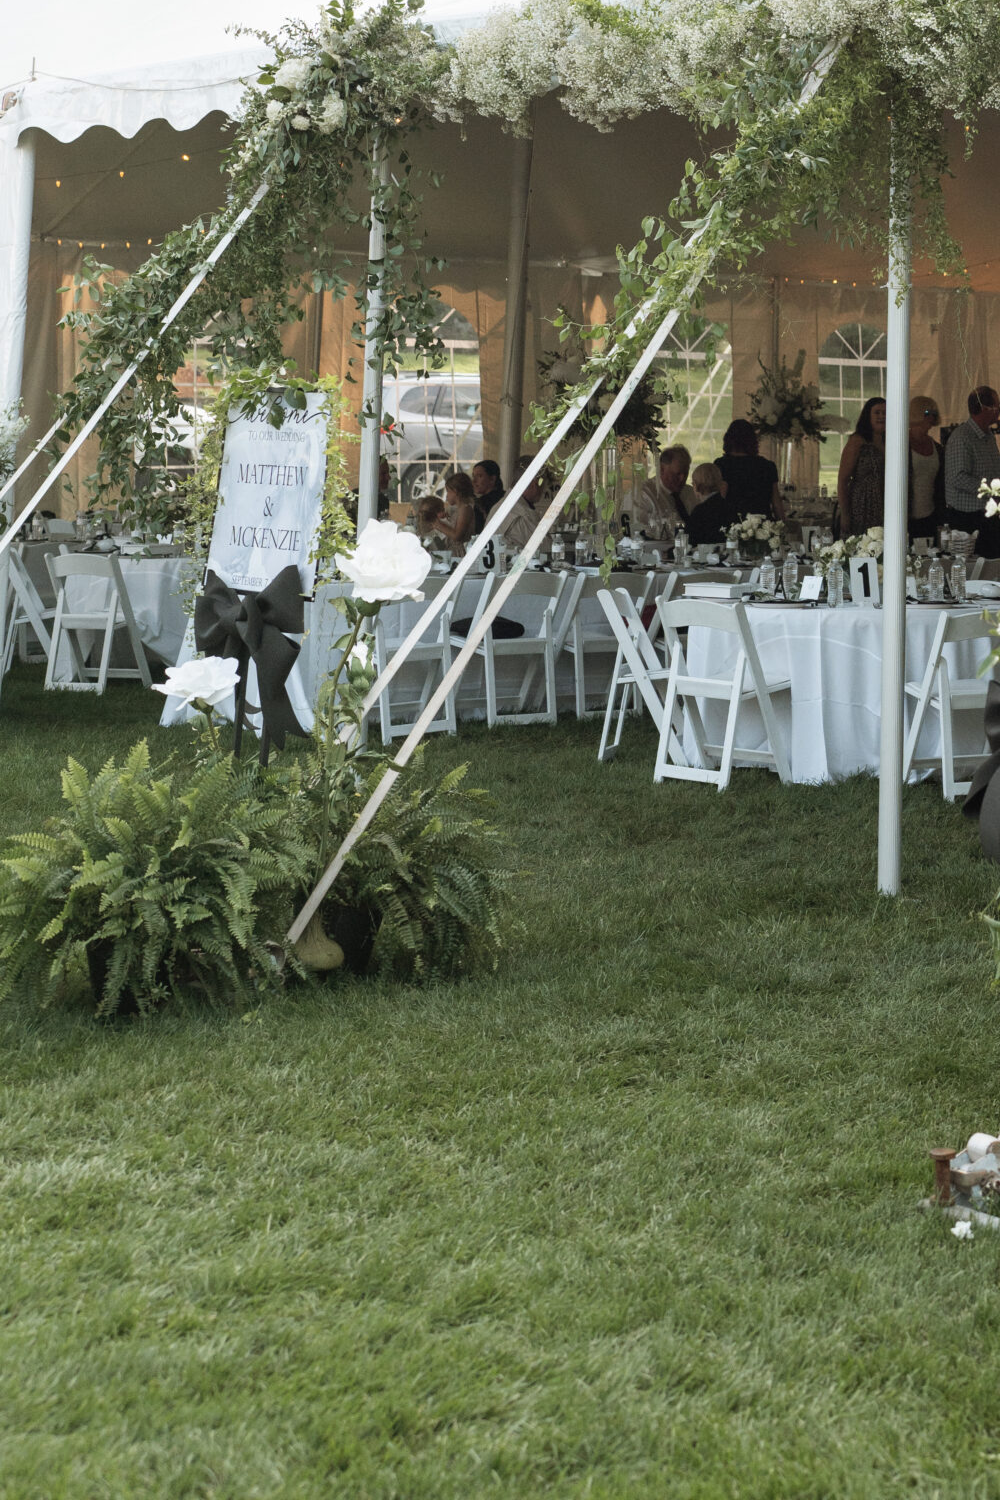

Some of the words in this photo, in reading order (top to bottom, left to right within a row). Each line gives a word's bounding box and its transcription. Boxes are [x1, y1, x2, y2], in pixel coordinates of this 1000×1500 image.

[248, 430, 257, 441] TO
[259, 430, 273, 441] OUR
[275, 430, 306, 443] WEDDING
[237, 463, 309, 486] MATTHEW
[263, 495, 274, 517] &
[229, 525, 301, 552] MCKENZIE
[482, 539, 496, 569] 3
[231, 574, 263, 587] SEPTEMBER
[857, 562, 871, 597] 1
